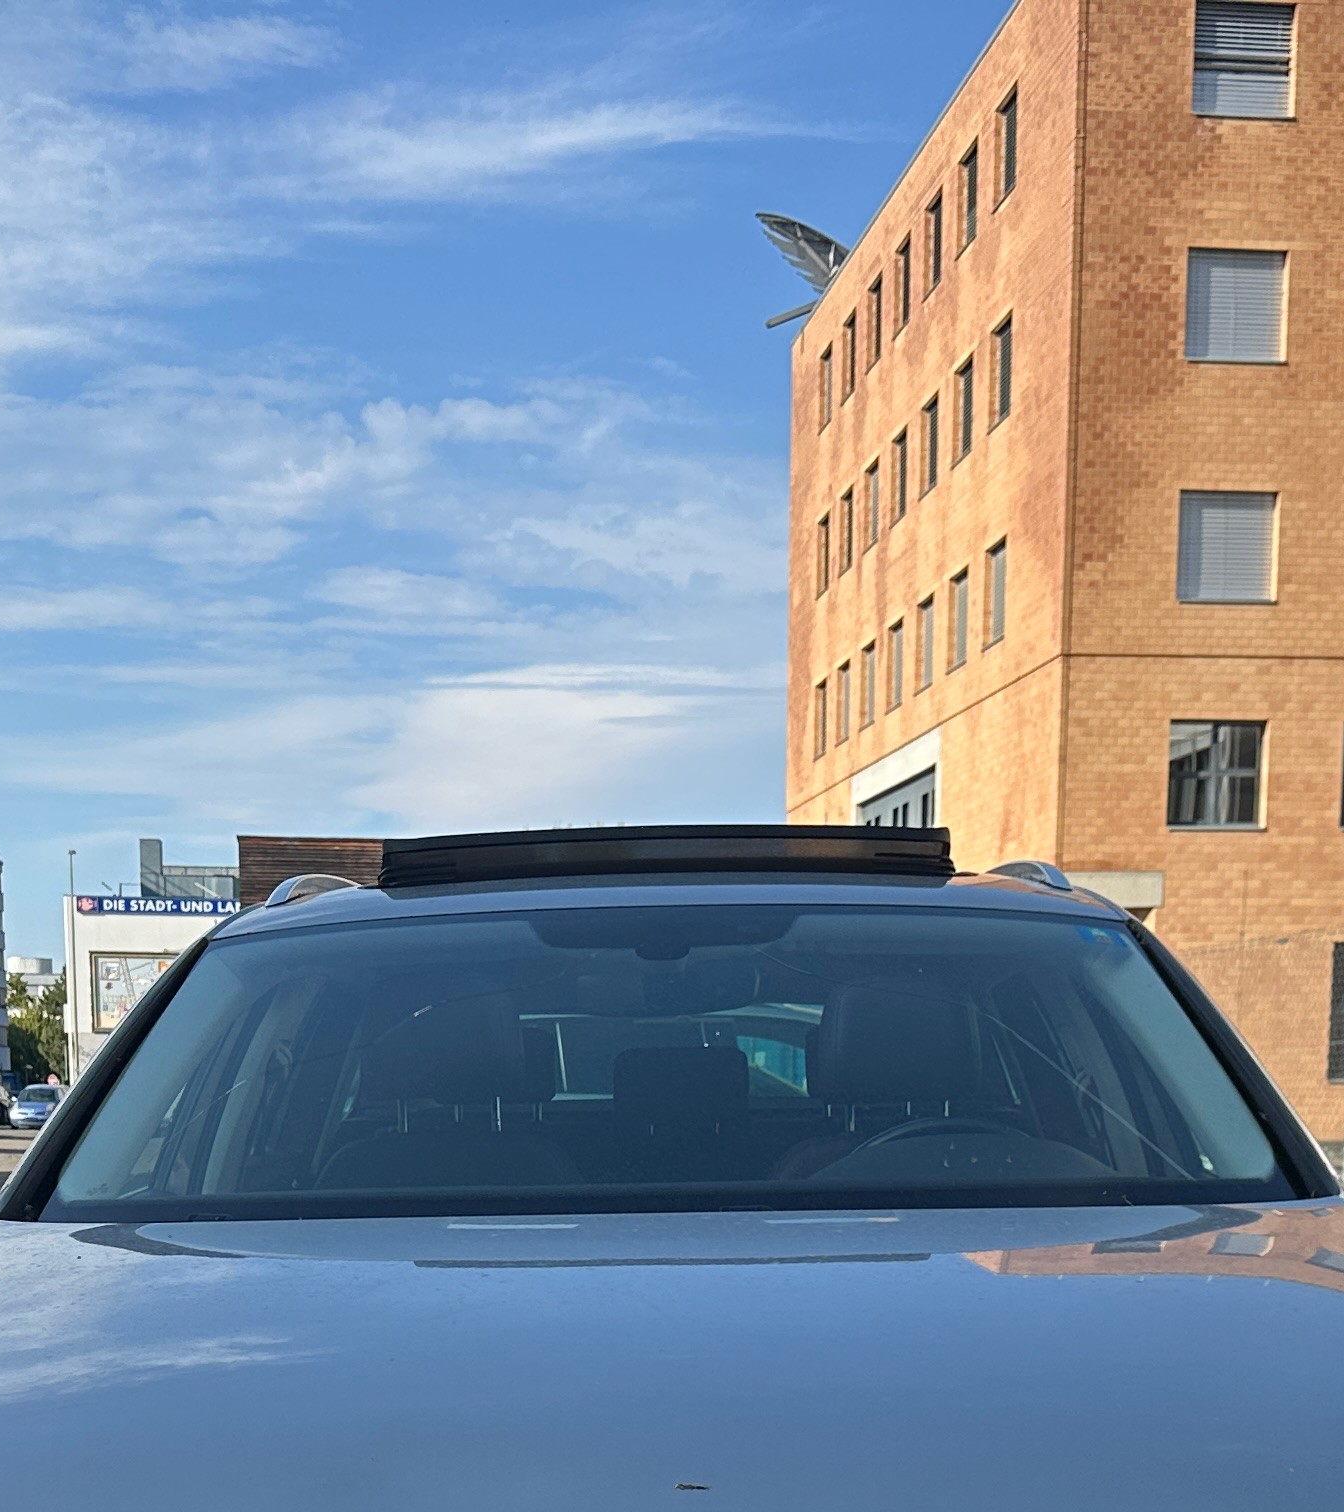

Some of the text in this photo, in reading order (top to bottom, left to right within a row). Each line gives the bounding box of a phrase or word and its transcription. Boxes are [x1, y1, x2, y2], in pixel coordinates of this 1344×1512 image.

[103, 900, 126, 911] DIE
[130, 901, 177, 912] STADT-
[180, 901, 213, 913] UND
